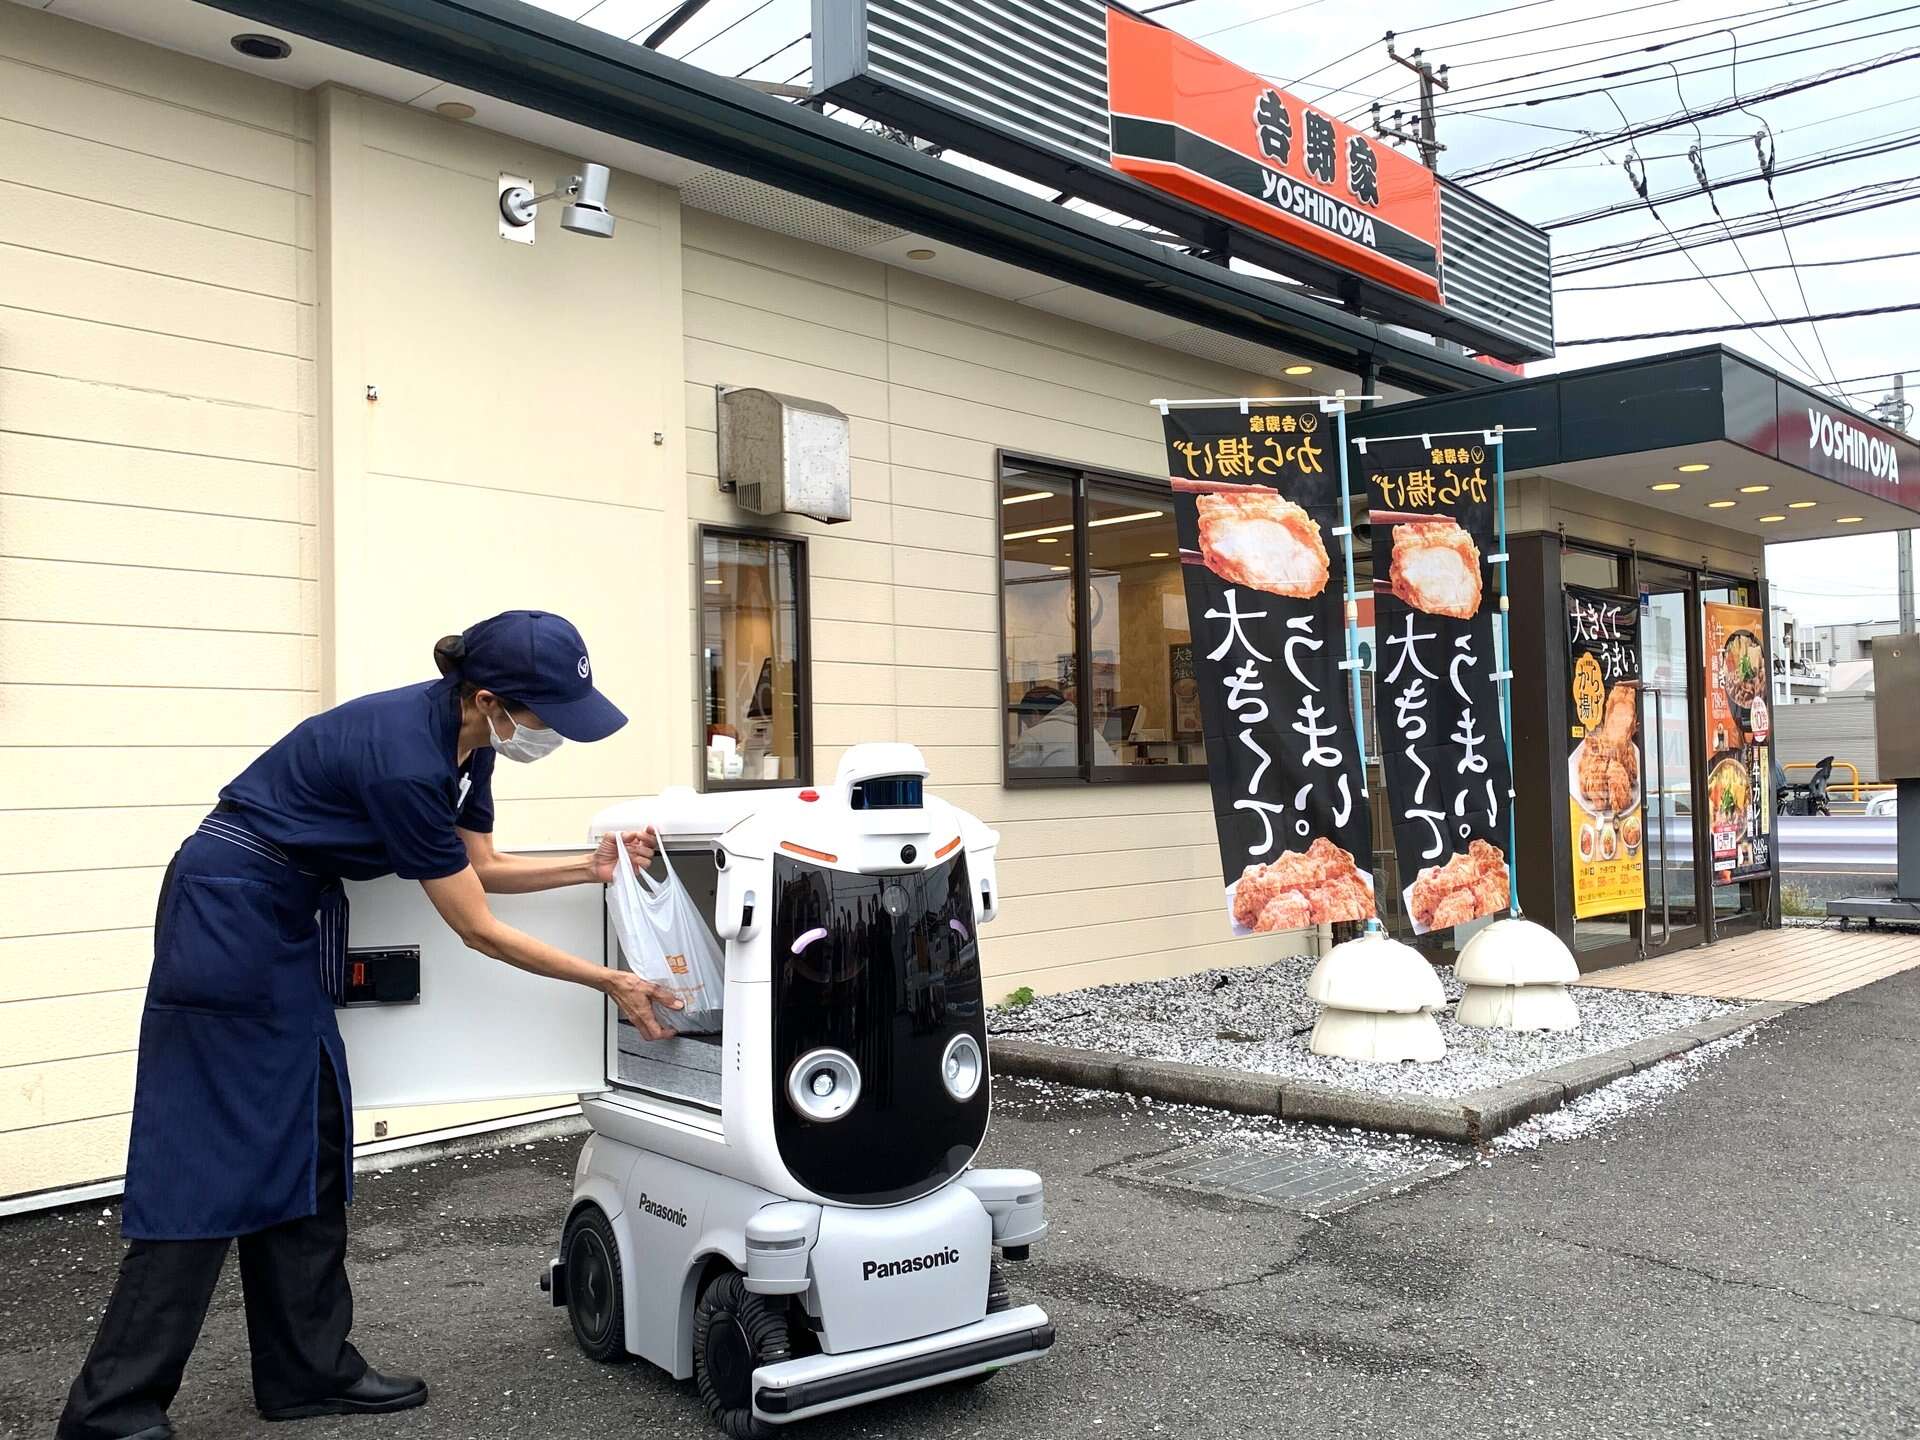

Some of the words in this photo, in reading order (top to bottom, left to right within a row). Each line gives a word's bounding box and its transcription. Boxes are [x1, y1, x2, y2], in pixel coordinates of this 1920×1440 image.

[1262, 170, 1376, 247] YOSHINOYA
[1808, 408, 1899, 484] YOSHINOYA
[1571, 598, 1622, 643] 大きくて
[1601, 641, 1639, 681] うまい。
[639, 1192, 688, 1228] Panasonic
[862, 1246, 960, 1281] Panasonic
